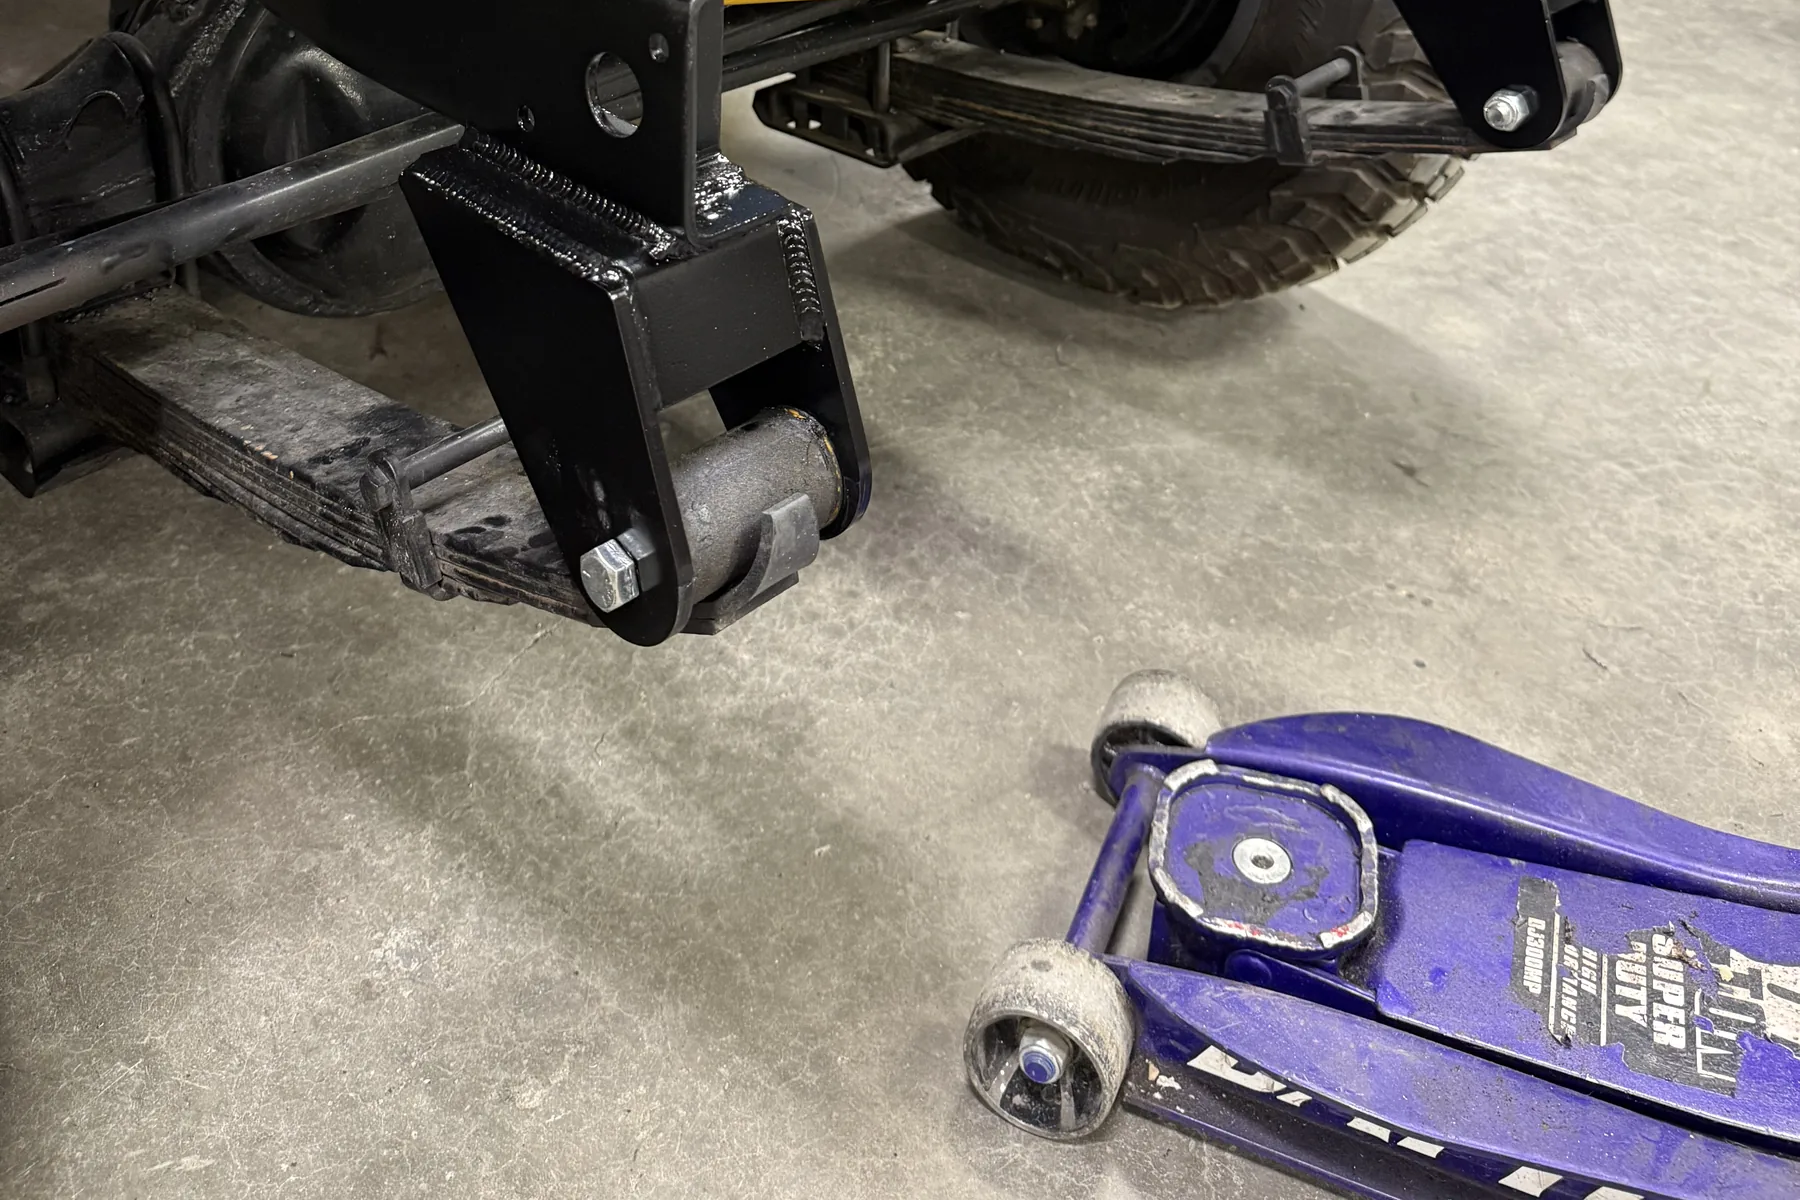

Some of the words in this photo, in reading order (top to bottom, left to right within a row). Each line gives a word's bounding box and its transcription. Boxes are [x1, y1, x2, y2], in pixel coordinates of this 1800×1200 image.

[1523, 916, 1546, 995] DJ300MP
[1580, 945, 1598, 996] HIGH
[1651, 933, 1686, 1050] SUPER
